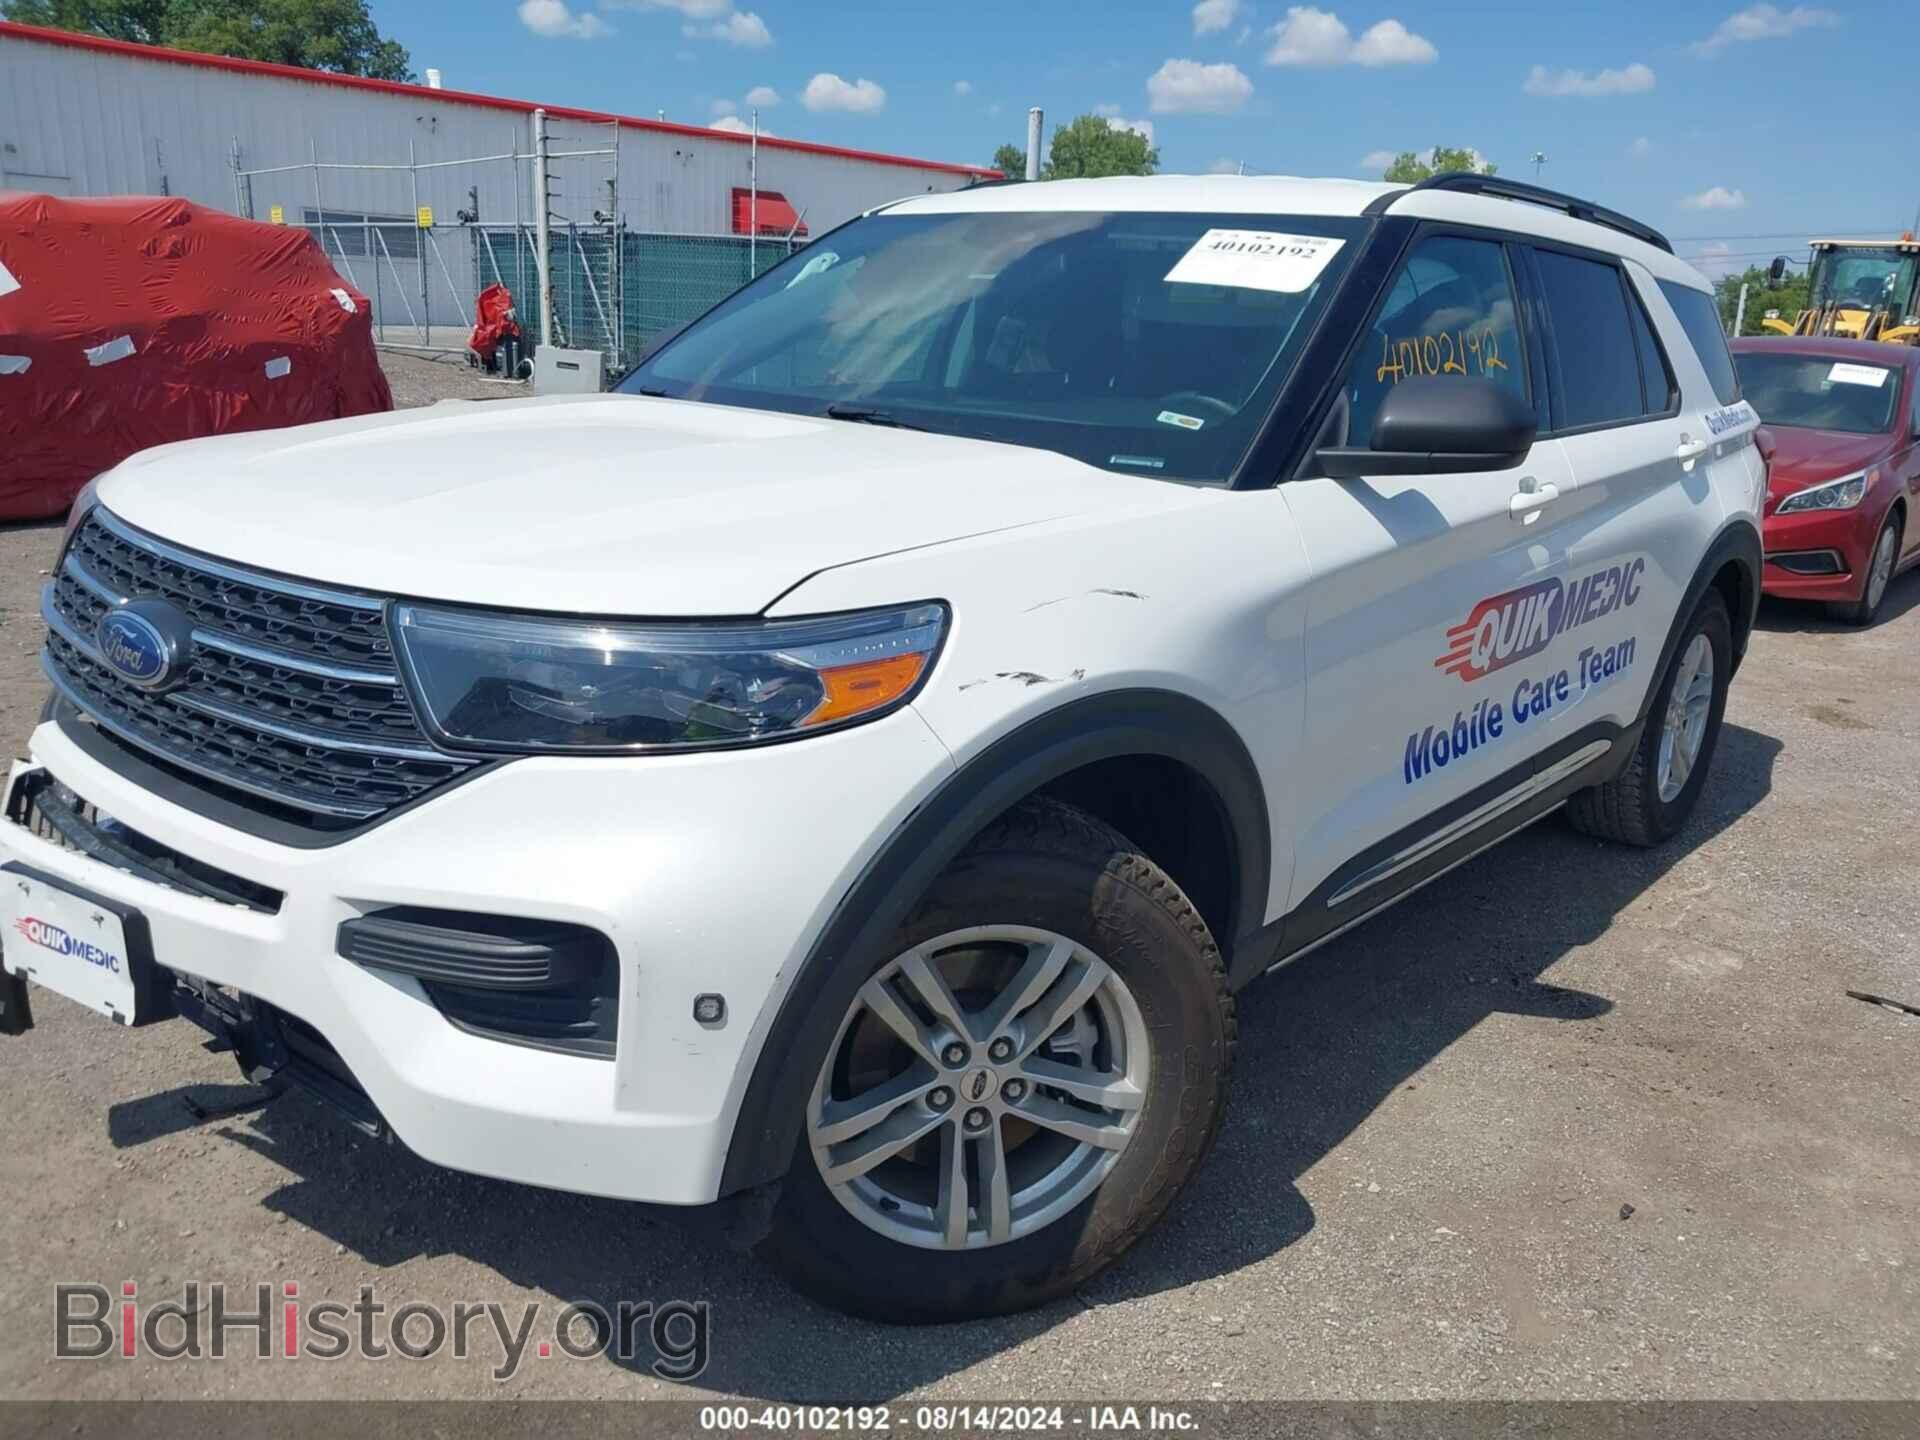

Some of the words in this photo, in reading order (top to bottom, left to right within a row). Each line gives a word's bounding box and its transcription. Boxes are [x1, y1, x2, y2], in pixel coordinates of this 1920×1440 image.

[1208, 238, 1318, 259] 40102192
[1376, 327, 1508, 384] 40102192
[104, 623, 145, 672] Ford
[1403, 697, 1504, 785] Mobile
[1511, 668, 1570, 726] Care
[1578, 636, 1637, 690] Team
